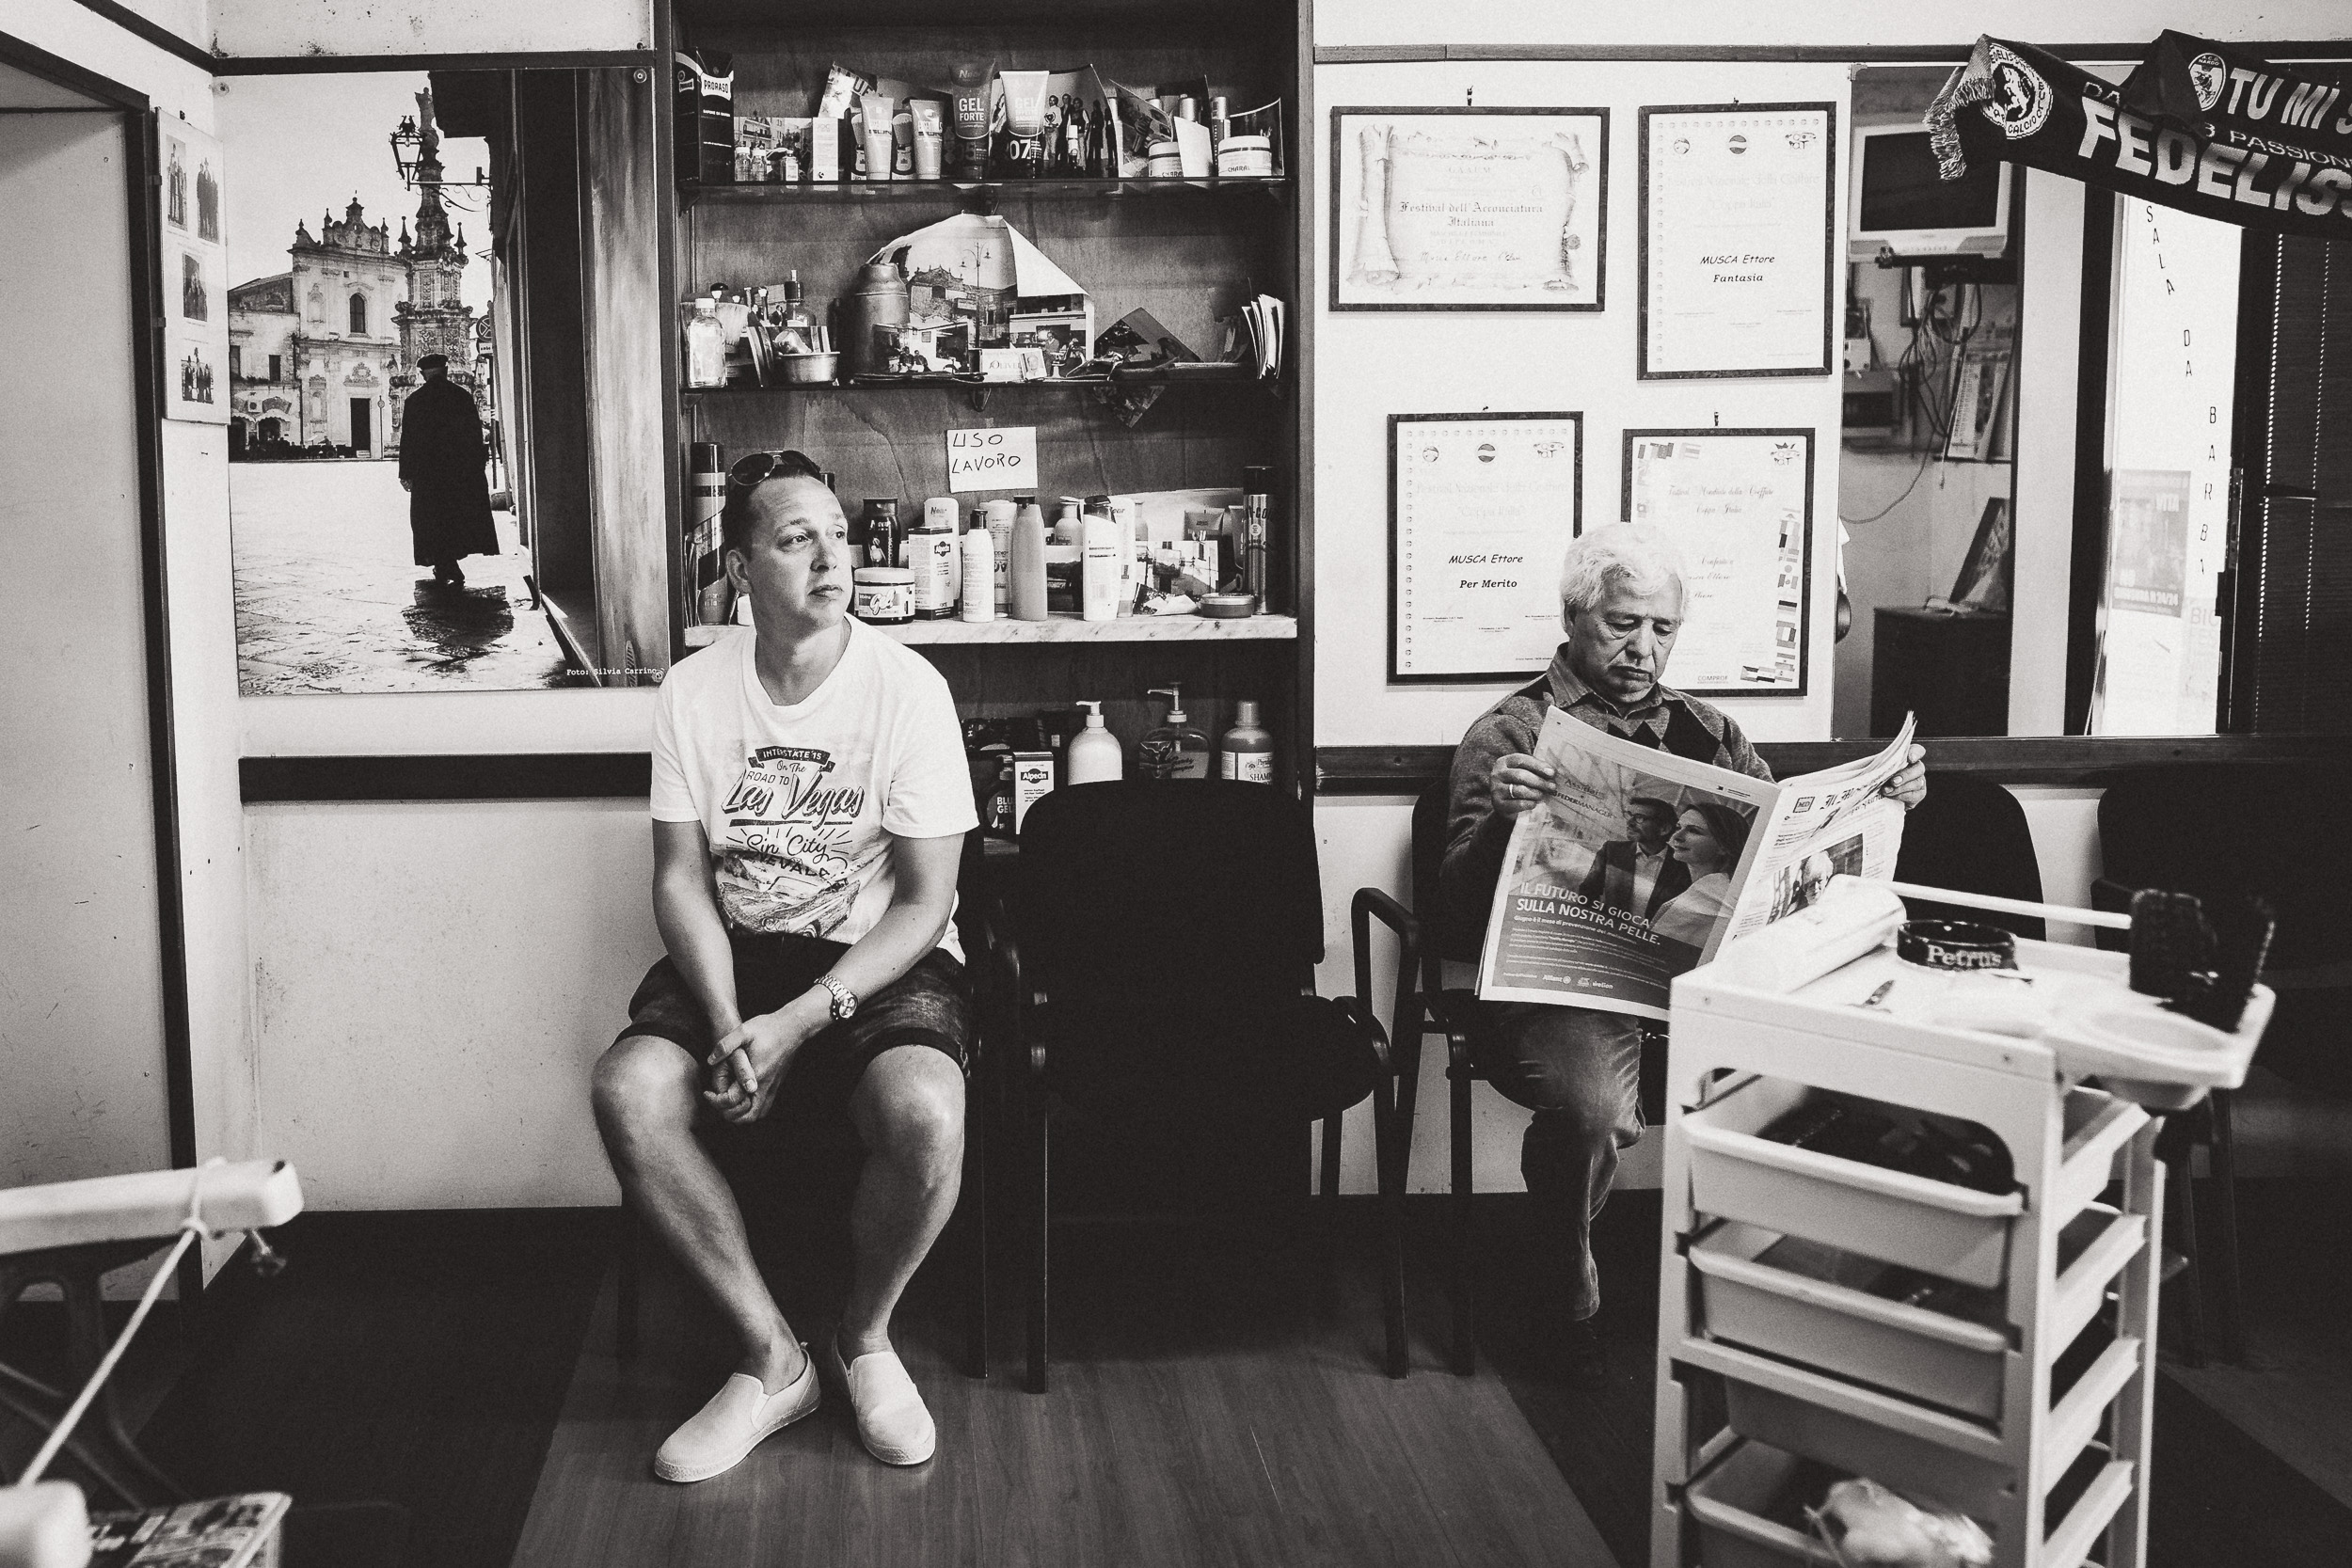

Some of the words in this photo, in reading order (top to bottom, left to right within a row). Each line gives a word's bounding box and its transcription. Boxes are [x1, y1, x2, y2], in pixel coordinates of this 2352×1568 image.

[704, 79, 729, 94] PRORASO
[959, 97, 985, 112] GEL
[2227, 67, 2283, 120] TU
[2280, 82, 2340, 130] MI
[959, 112, 985, 122] FORTE
[2229, 130, 2352, 168] PASSION
[1399, 201, 1445, 214] Festival
[1448, 215, 1495, 227] Italiana
[1700, 256, 1739, 265] MUSCA
[1742, 254, 1775, 264] Ettore
[1713, 273, 1764, 283] Fantasia
[952, 432, 1004, 448] USO
[951, 452, 1022, 474] LAVORO
[1449, 554, 1486, 564] MUSCA
[1490, 553, 1524, 564] Ettore
[1459, 580, 1479, 589] Per
[1481, 578, 1518, 589] Merito
[566, 668, 590, 676] Foto:
[594, 667, 622, 675] Silvia
[624, 667, 658, 675] Carrino
[776, 759, 788, 772] On
[789, 762, 806, 773] The
[746, 770, 775, 784] ROAD
[779, 774, 790, 786] TO
[1023, 771, 1047, 783] Alpecin
[721, 768, 773, 816] Las
[780, 770, 865, 831] Vegas
[746, 833, 780, 855] Sin
[787, 833, 830, 864] City
[1520, 882, 1532, 895] IL
[1534, 883, 1589, 906] FUTURO
[1591, 900, 1605, 911] SI
[1608, 906, 1651, 930] GIOCA
[1516, 898, 1555, 914] SULLA
[1558, 903, 1614, 928] NOSTRA
[1618, 923, 1661, 946] PELLE.
[1927, 943, 2002, 969] Petrus
